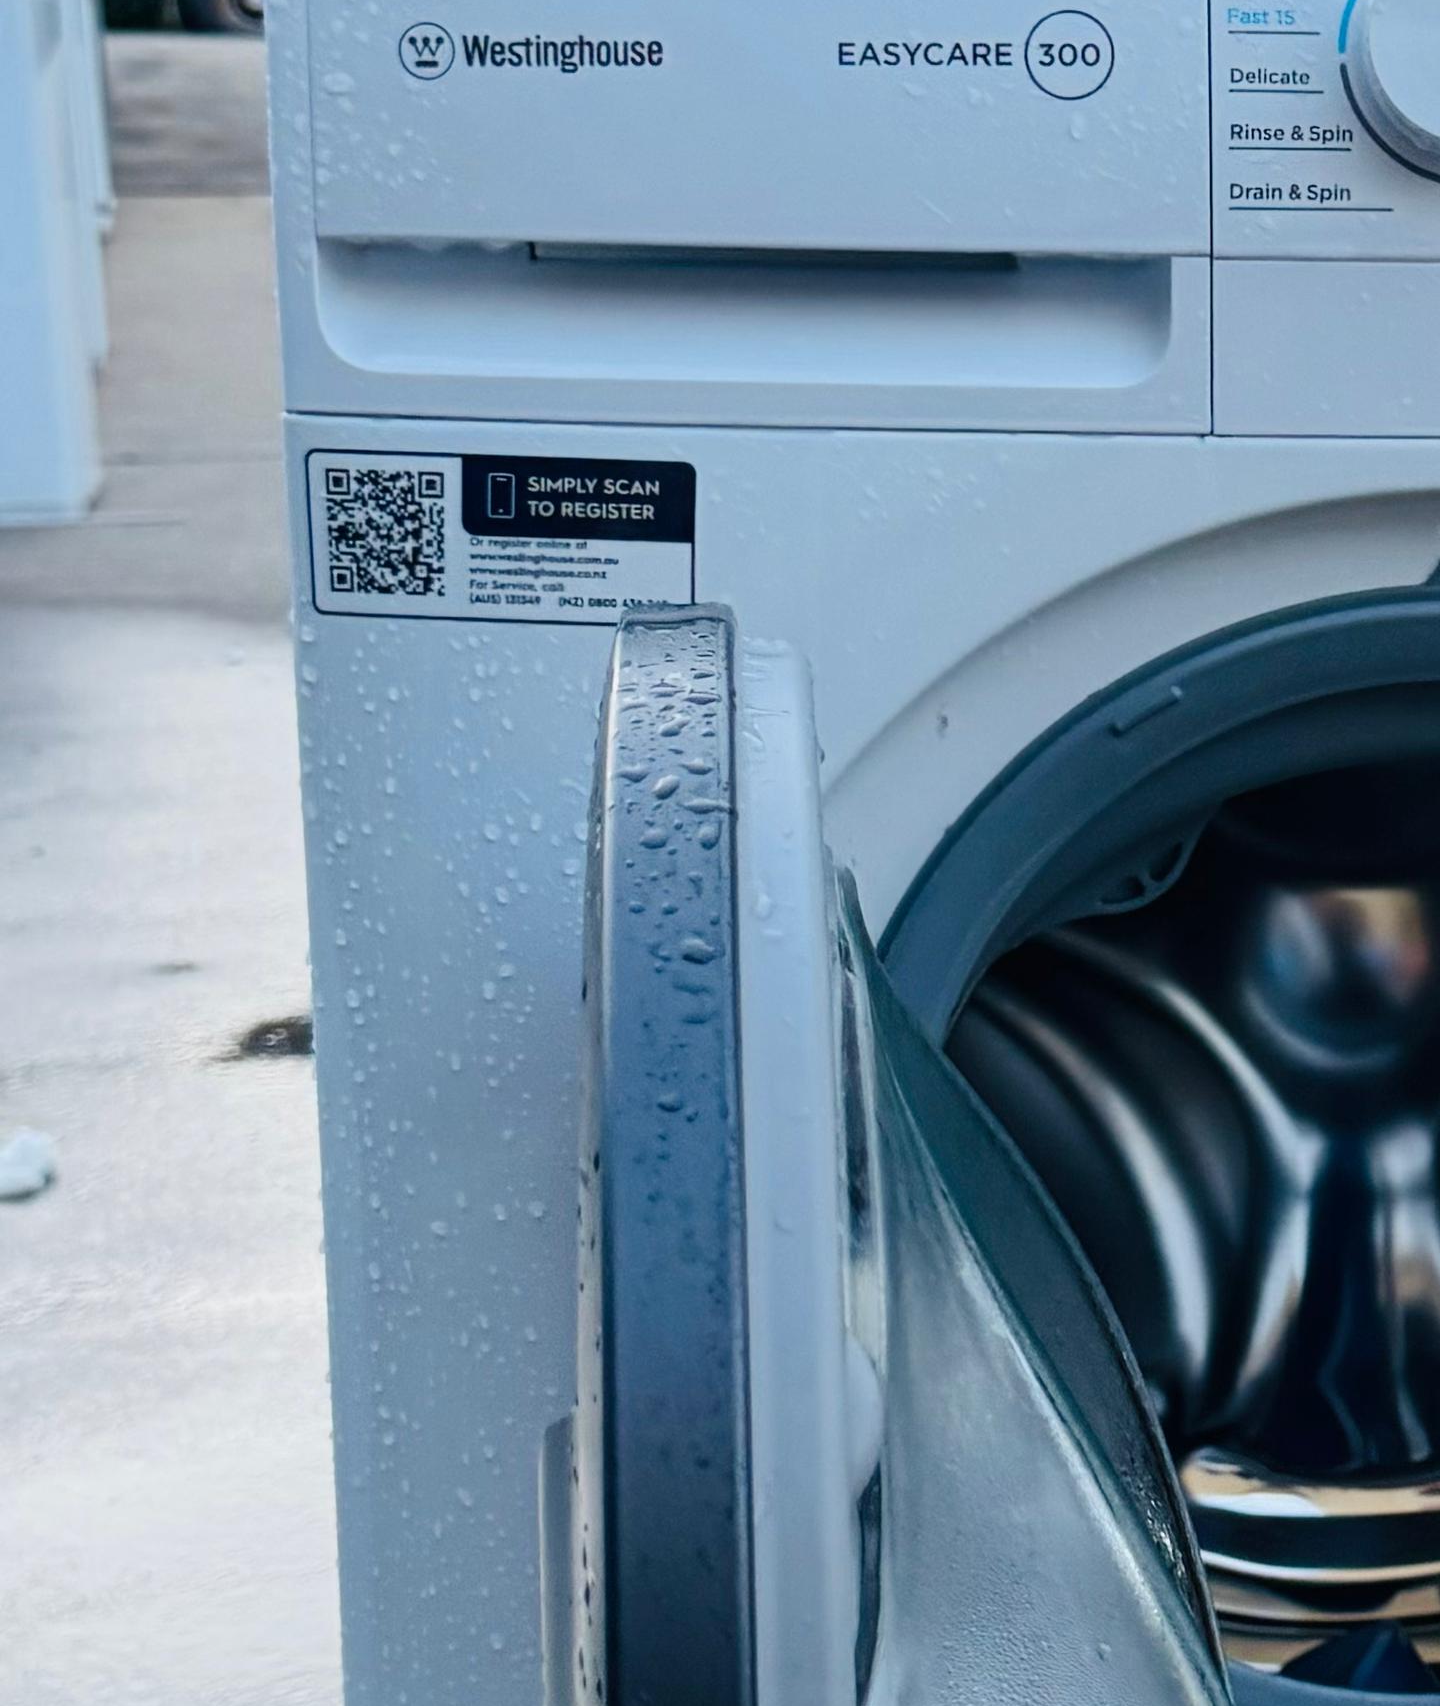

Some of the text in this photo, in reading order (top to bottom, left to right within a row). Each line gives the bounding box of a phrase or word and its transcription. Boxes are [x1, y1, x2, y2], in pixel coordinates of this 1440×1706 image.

[1226, 8, 1296, 25] Fast 15
[461, 34, 664, 74] Westinghouse
[838, 42, 1101, 67] EASYCARE 300
[1230, 67, 1311, 85] Delicate
[1230, 123, 1354, 144] Rinse & Spin
[1229, 182, 1352, 204] Drain & Spin
[527, 476, 660, 496] SIMPLY SCAN
[527, 500, 656, 520] TO REGISTER
[469, 536, 486, 547] Or
[488, 538, 532, 550] register
[536, 539, 571, 549] online
[469, 579, 489, 590] For
